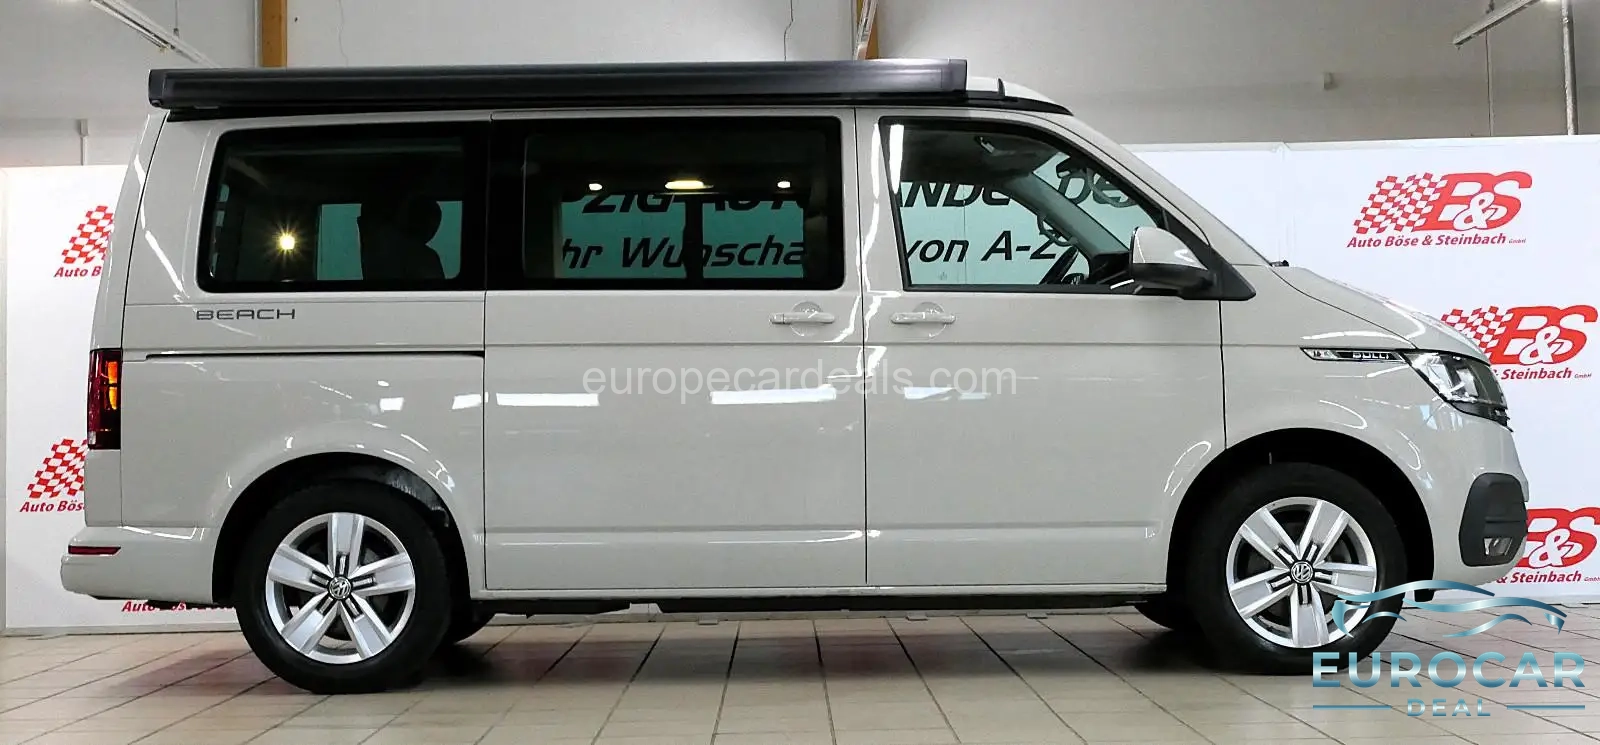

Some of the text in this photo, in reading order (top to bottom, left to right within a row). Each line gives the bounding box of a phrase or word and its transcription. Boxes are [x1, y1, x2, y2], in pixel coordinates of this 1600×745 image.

[1347, 236, 1381, 248] Auto
[1385, 235, 1418, 247] Böse
[1421, 235, 1433, 246] &
[1435, 233, 1506, 246] Steinbach
[53, 266, 89, 278] Auto
[196, 309, 295, 321] BEACH
[1500, 367, 1573, 381] Steinbach
[20, 500, 84, 513] Auto Bös
[1510, 570, 1582, 583] Steinbach
